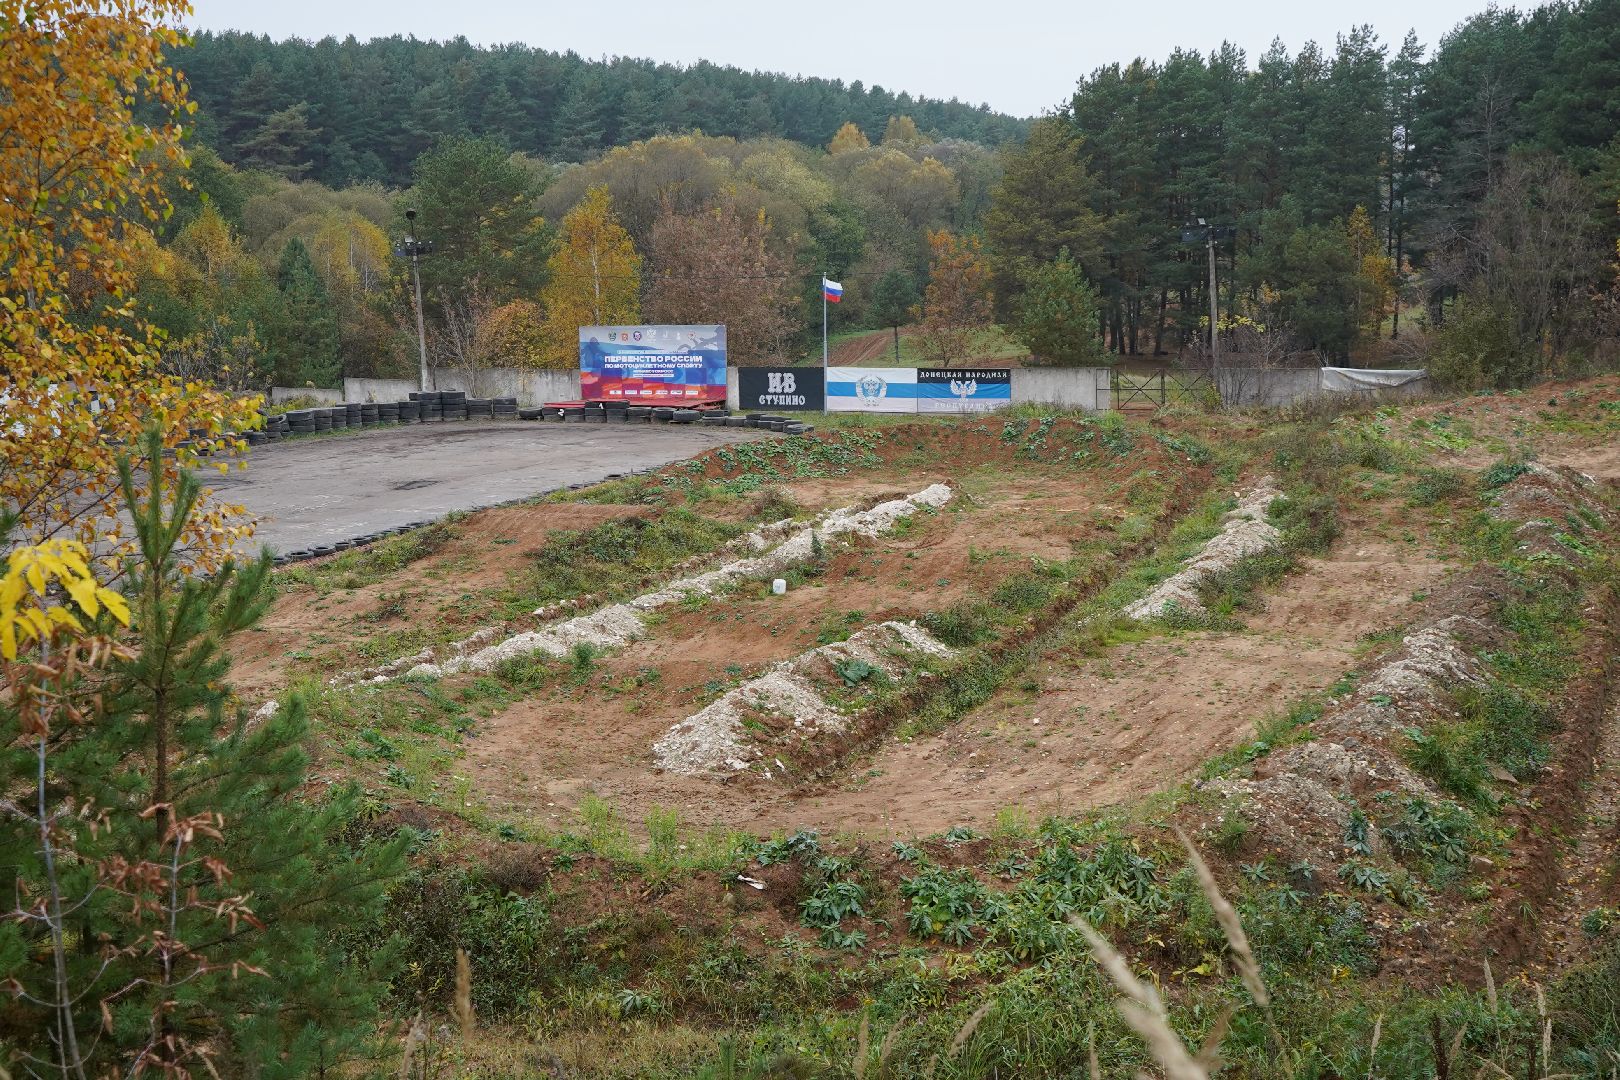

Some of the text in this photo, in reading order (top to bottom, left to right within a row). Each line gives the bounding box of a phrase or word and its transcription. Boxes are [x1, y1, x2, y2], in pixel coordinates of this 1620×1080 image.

[604, 355, 703, 363] ПЕРВЕНСТВО РОССИИ
[919, 371, 1007, 379] ДОНЕЦКАЯ НАРОДНАЯ
[758, 394, 806, 406] СТУПИНО
[598, 402, 604, 410] 1
[557, 408, 565, 416] 2
